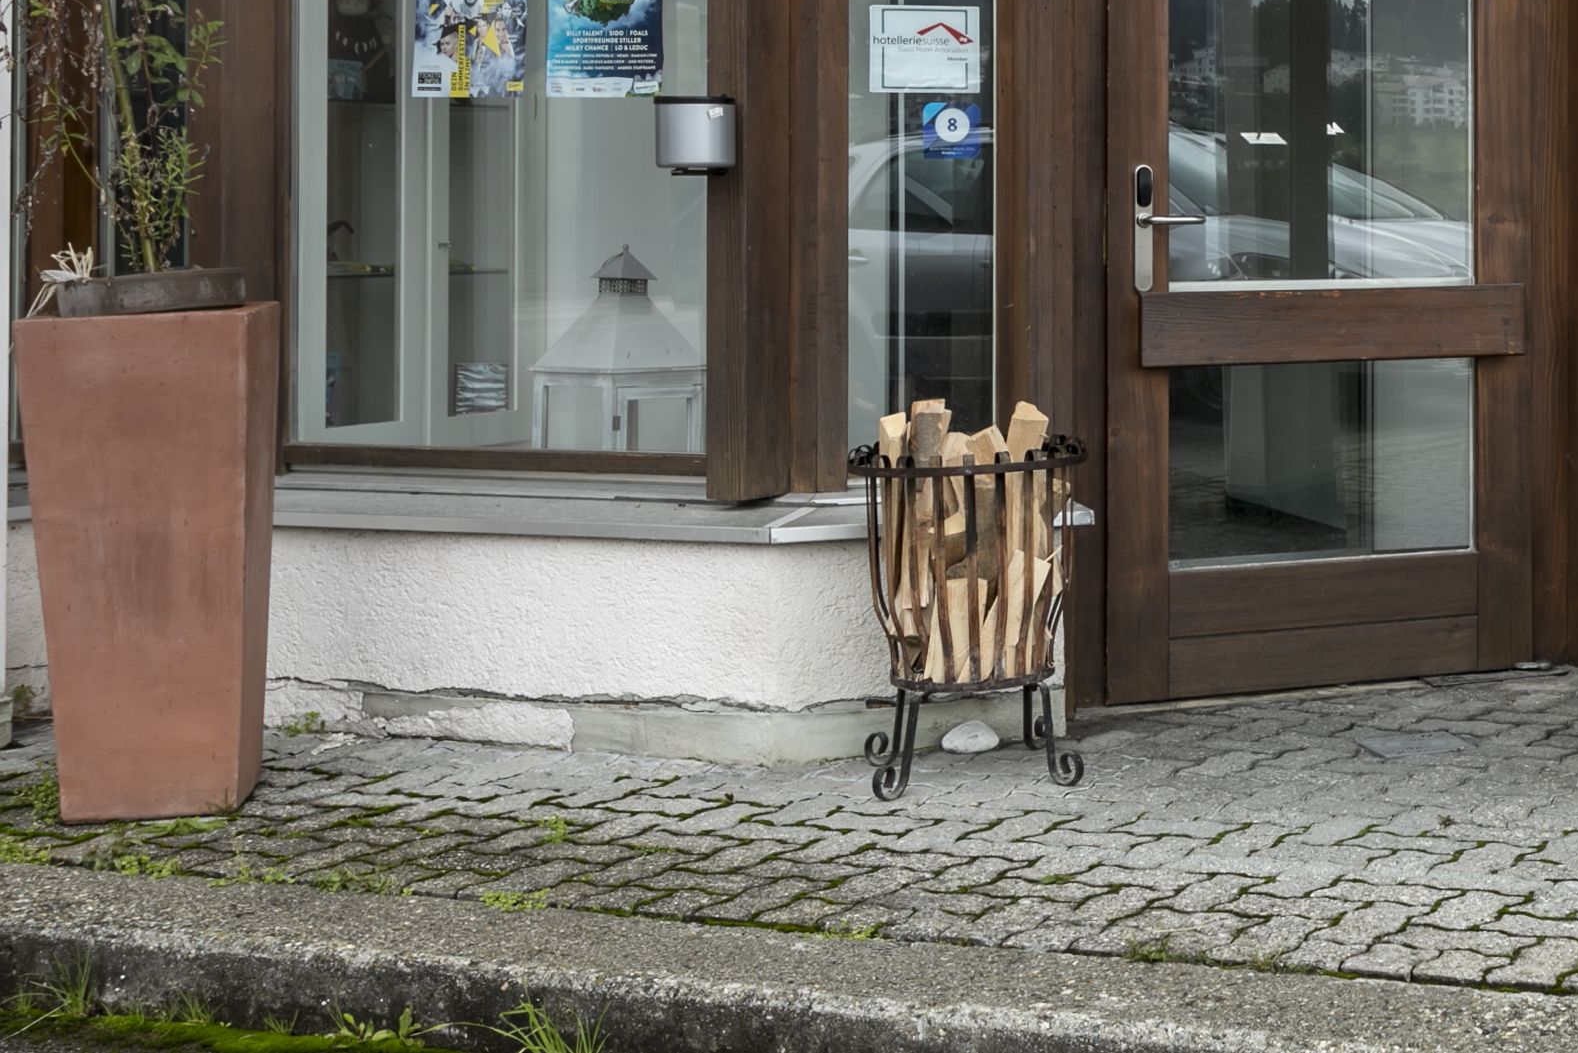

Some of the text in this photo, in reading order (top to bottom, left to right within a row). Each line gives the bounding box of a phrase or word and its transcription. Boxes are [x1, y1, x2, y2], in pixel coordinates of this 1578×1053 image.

[872, 35, 950, 46] hotelleriesuisse
[457, 26, 465, 91] SOMMERFESTIVAL
[947, 117, 958, 132] 8
